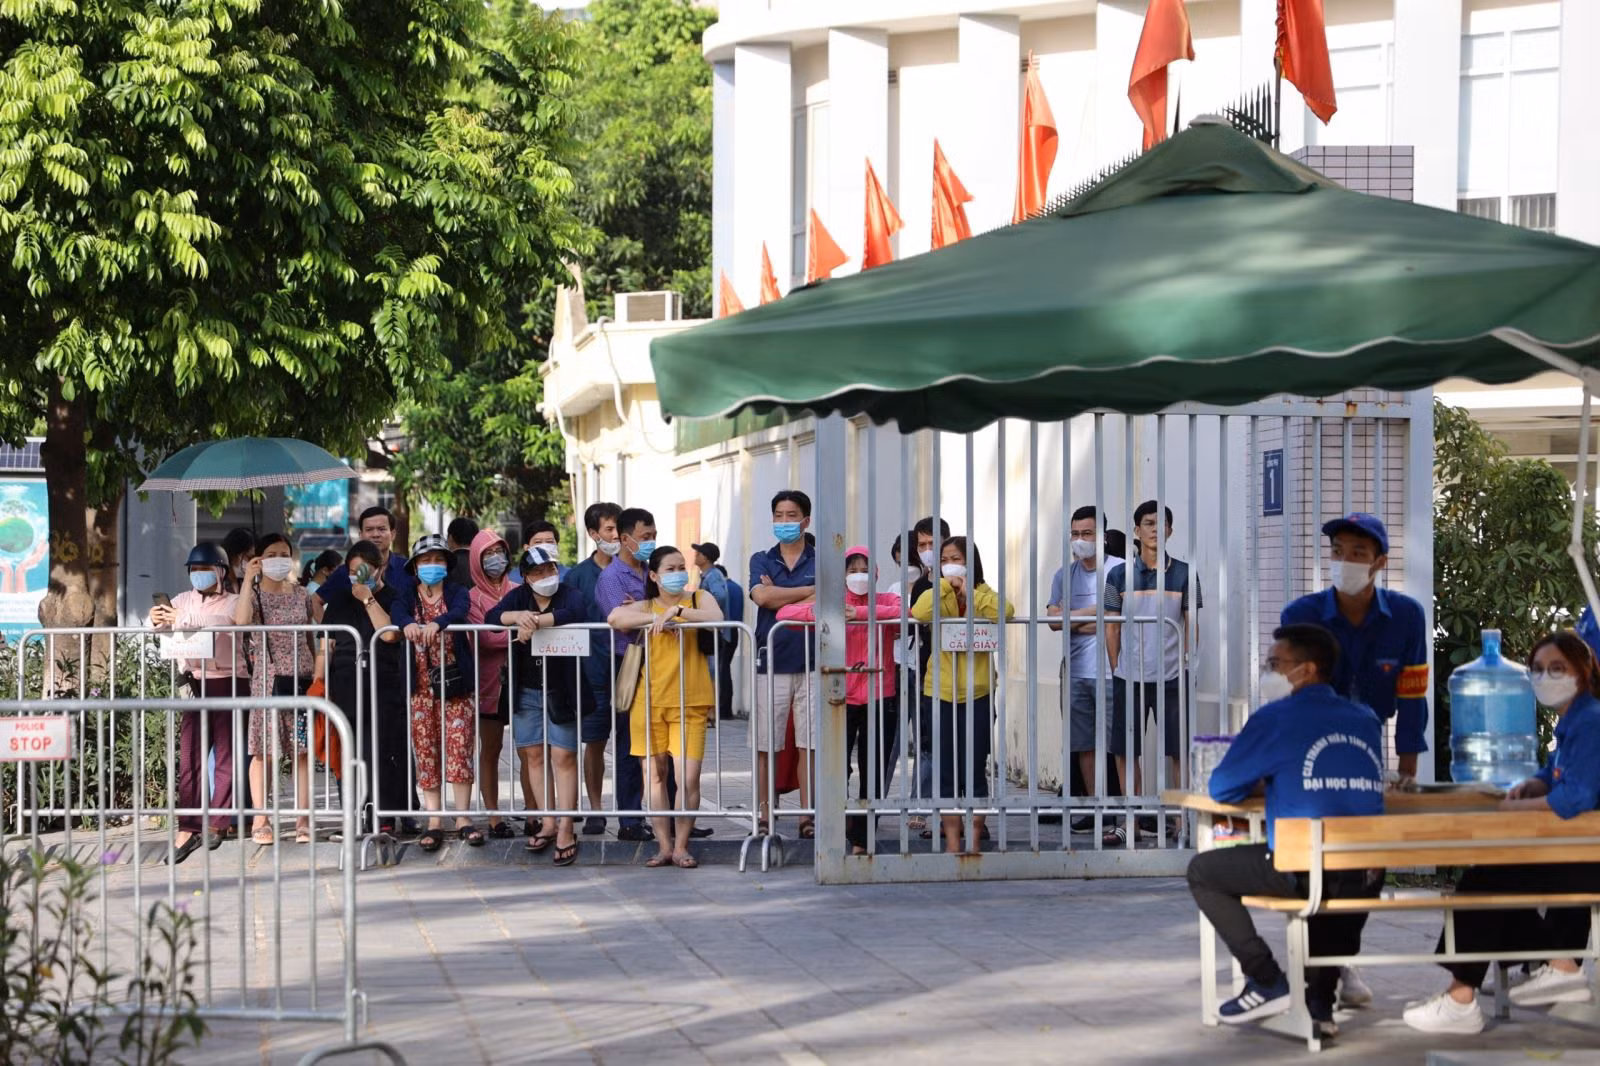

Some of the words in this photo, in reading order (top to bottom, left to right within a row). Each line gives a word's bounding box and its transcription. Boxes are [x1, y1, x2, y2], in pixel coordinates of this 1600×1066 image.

[1269, 468, 1275, 504] 1
[15, 722, 45, 731] POLICE
[10, 737, 52, 752] STOP
[1303, 777, 1323, 792] ĐẠI
[1325, 777, 1347, 791] HỌC
